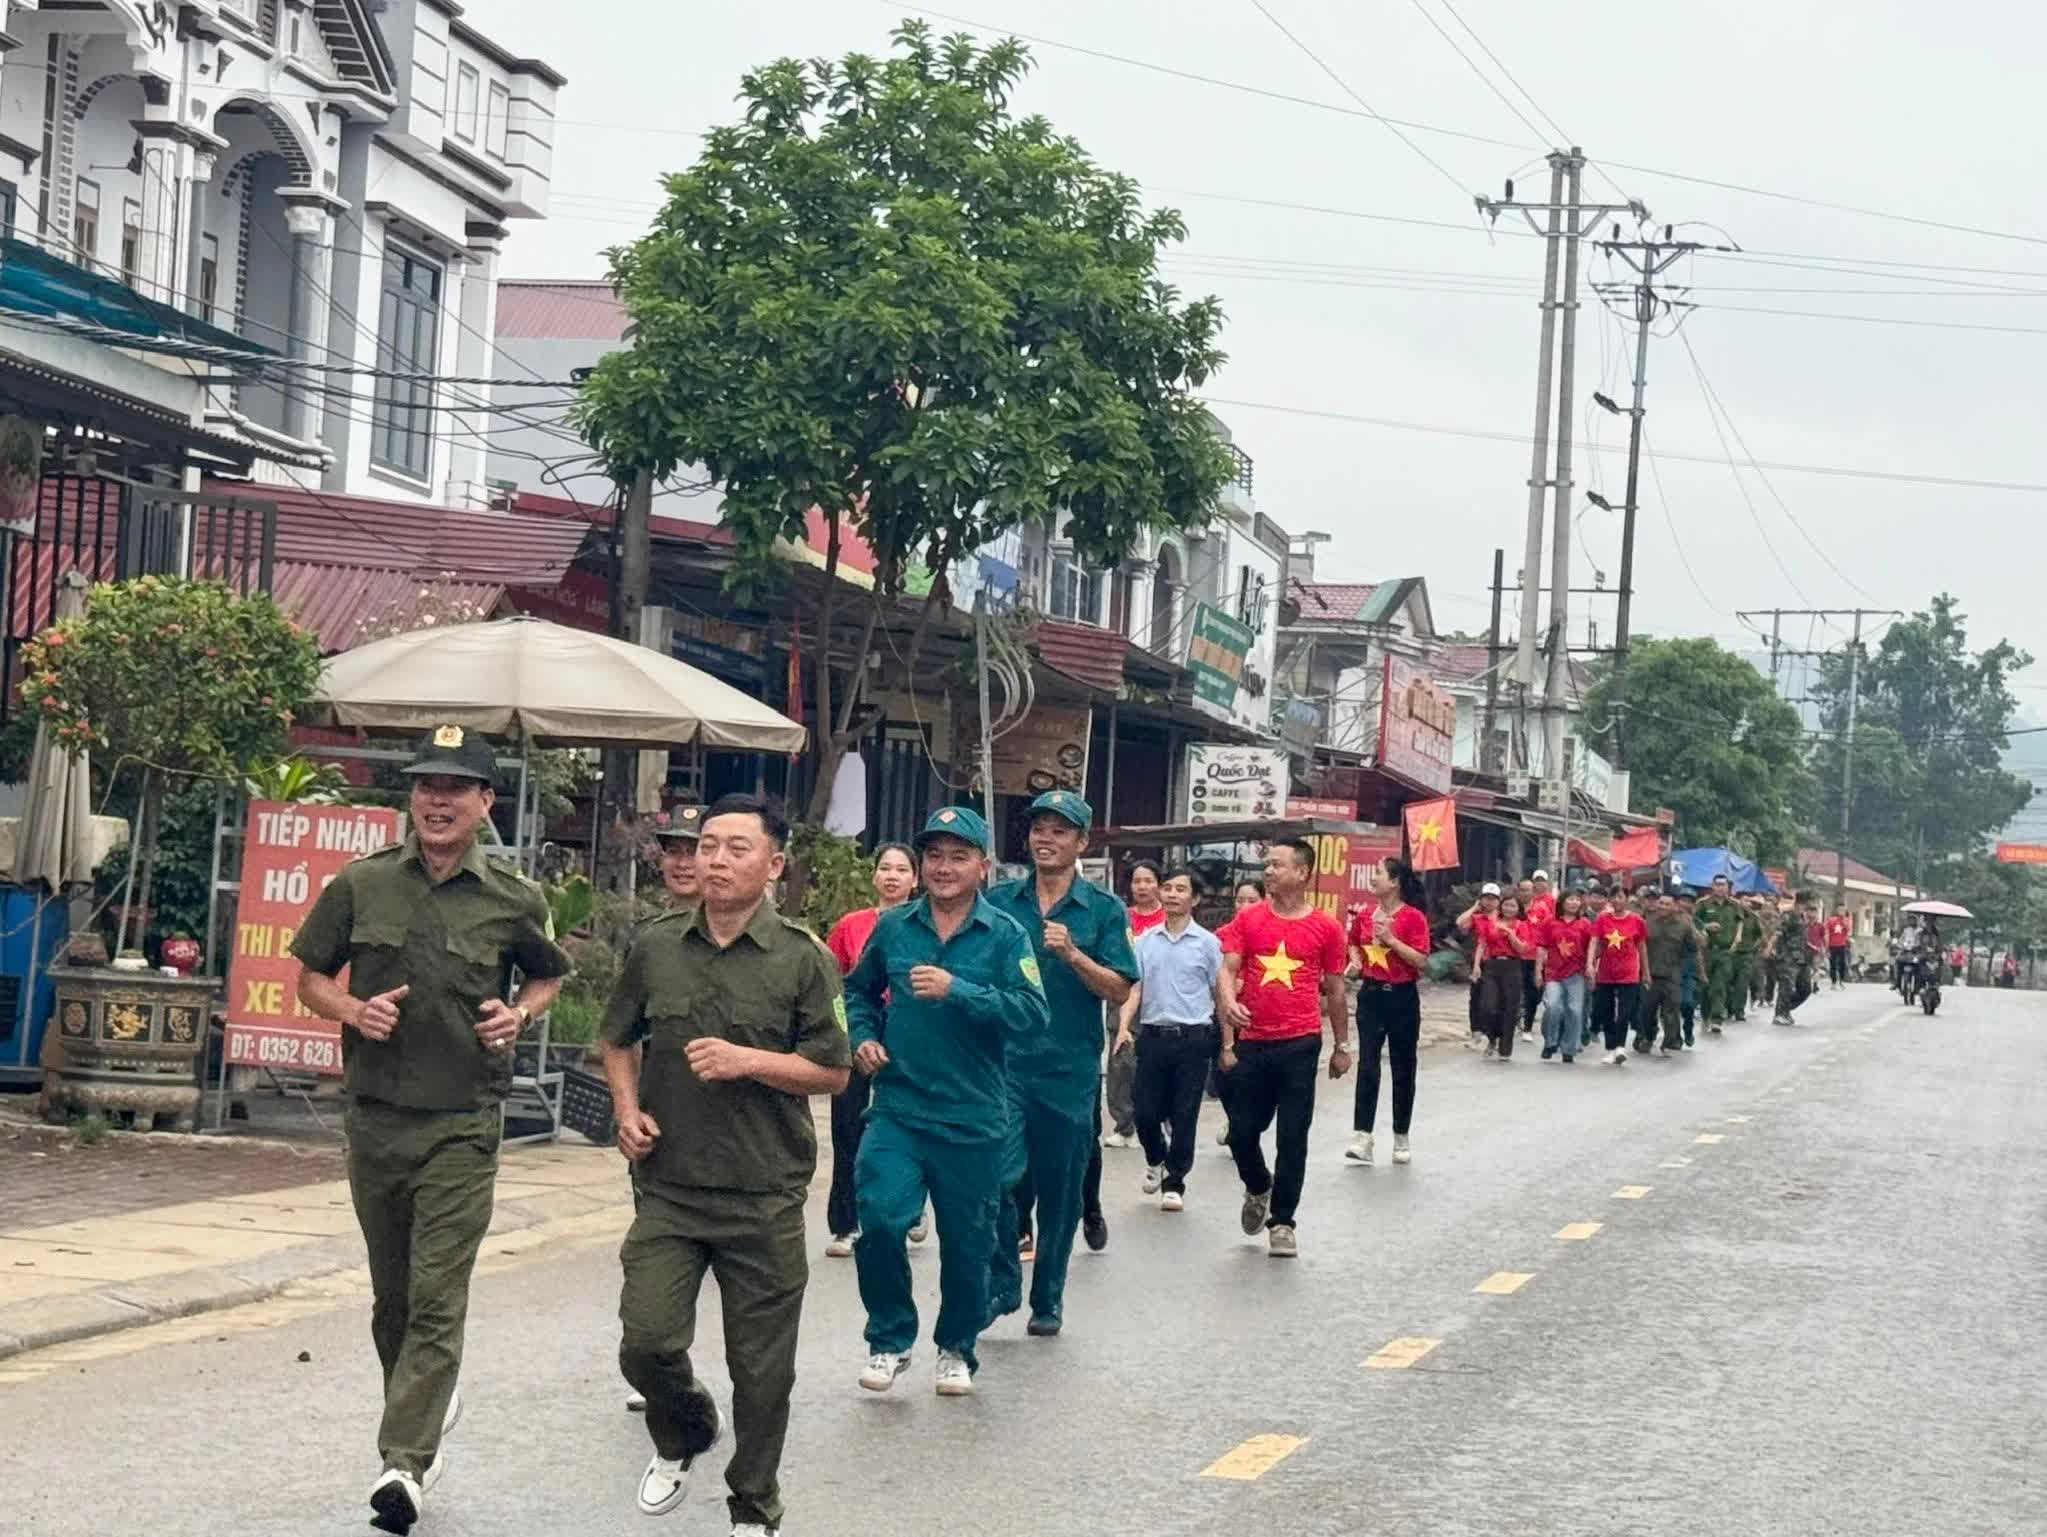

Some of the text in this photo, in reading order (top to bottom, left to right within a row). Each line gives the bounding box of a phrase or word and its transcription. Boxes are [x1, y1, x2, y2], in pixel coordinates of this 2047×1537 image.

[257, 805, 387, 858] TIẾP NHẬN
[263, 860, 309, 905] HỒ
[239, 923, 273, 957] THI
[242, 980, 285, 1015] XE
[259, 1036, 299, 1063] 0352
[303, 1040, 334, 1066] 626
